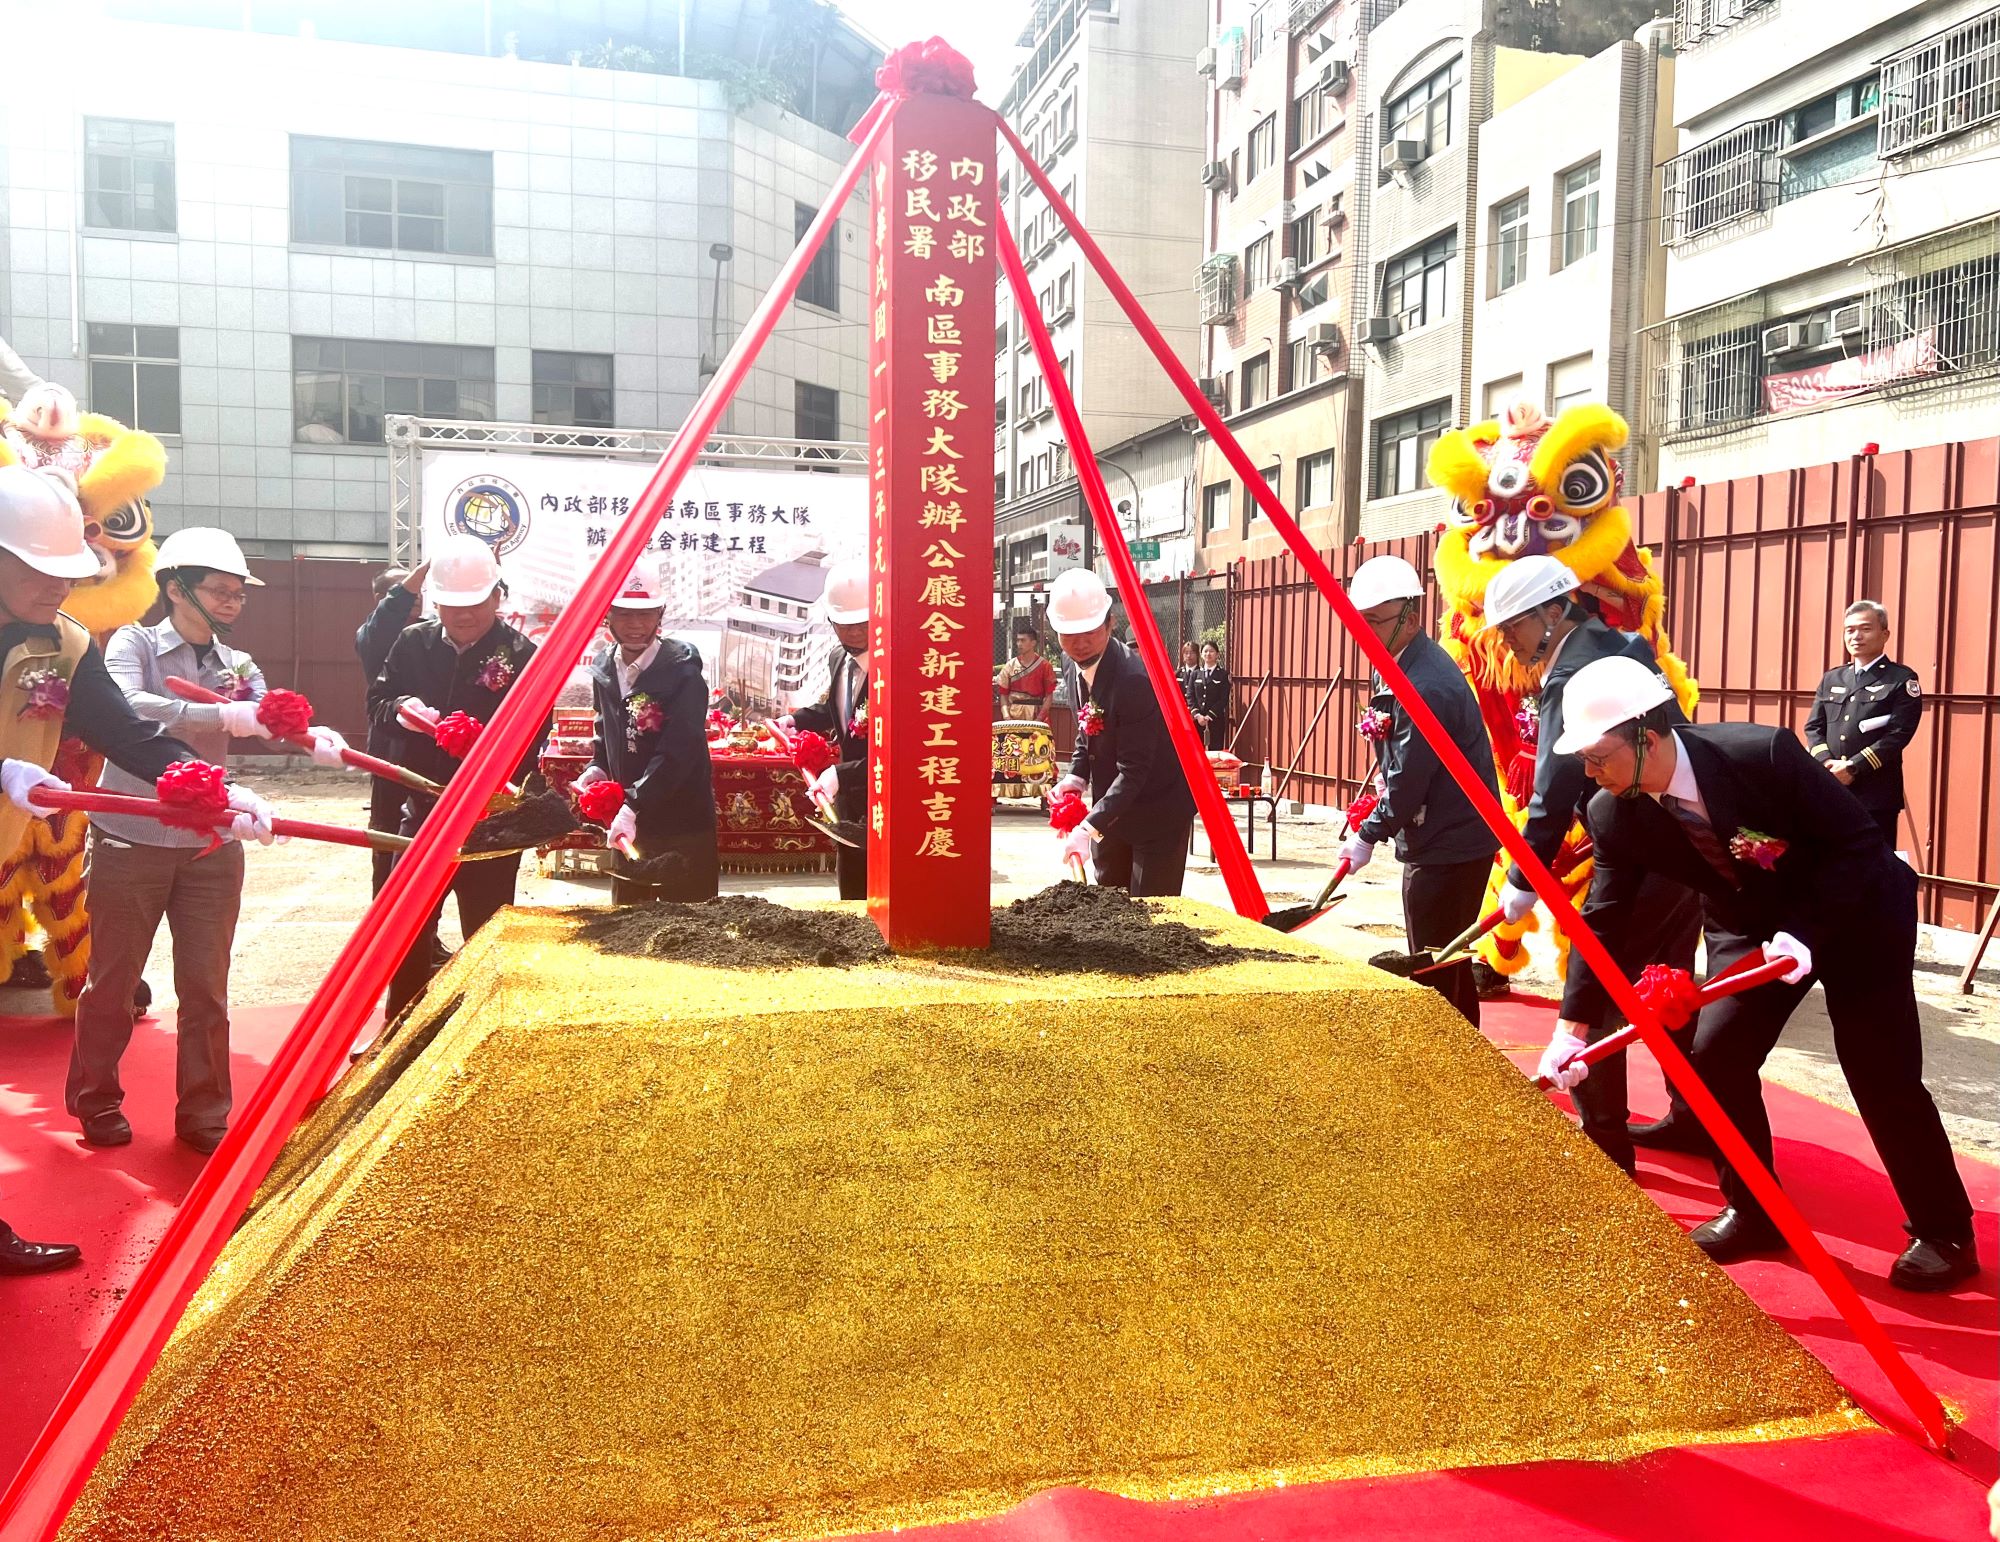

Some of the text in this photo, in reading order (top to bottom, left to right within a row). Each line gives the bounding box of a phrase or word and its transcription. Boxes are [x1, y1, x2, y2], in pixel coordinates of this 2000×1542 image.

[901, 149, 941, 260] 移民署
[540, 493, 811, 526] 內政部移署南區事務大隊
[586, 526, 767, 555] 辦舍新建工程
[915, 273, 969, 858] 南區事務大隊辦公廳舍新建工程吉慶
